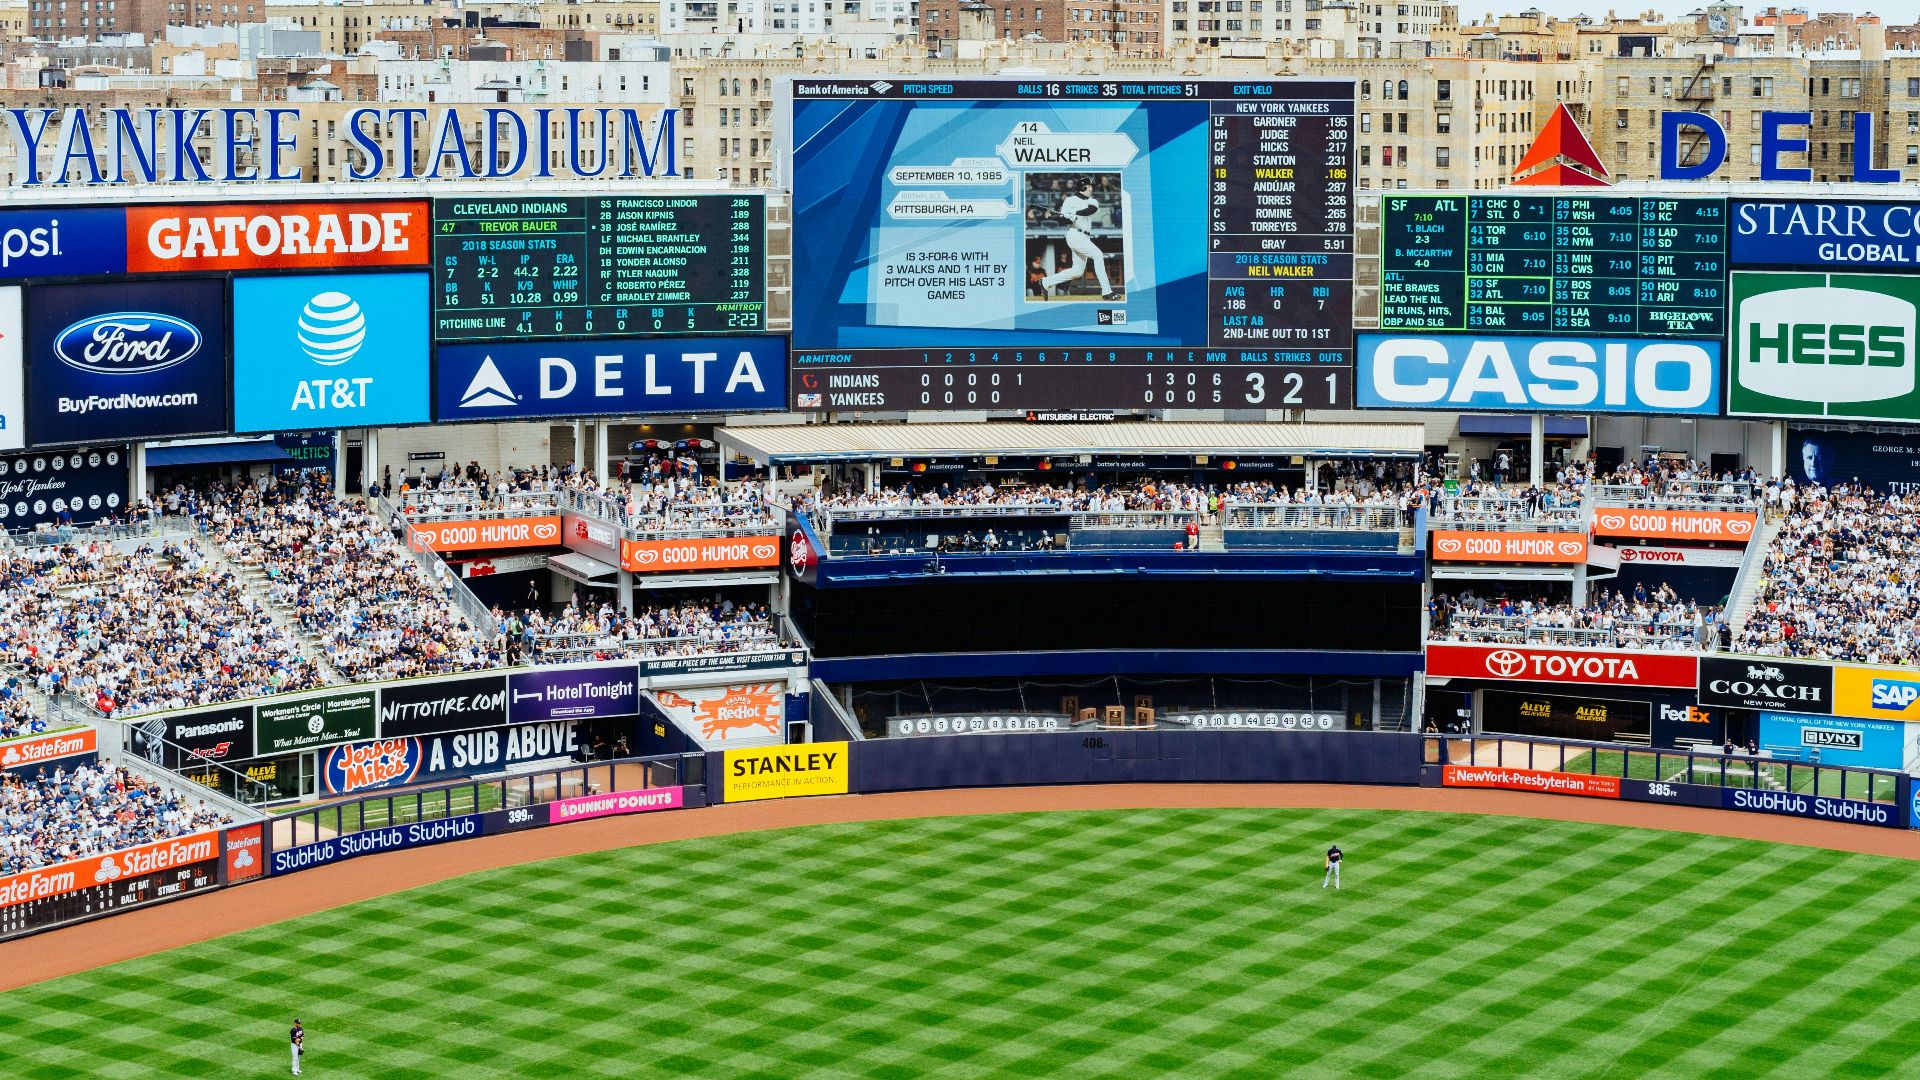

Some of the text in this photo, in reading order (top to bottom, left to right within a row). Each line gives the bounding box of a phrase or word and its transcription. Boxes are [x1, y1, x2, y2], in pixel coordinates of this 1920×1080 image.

[904, 84, 953, 94] PITCH SPEED
[1237, 104, 1329, 112] NEW YORK YANKEES
[1021, 123, 1037, 133] 14
[1215, 117, 1347, 127] LF GARDNER .195
[8, 108, 682, 184] YANKEE STADIUM
[1014, 137, 1035, 146] NEIL
[1015, 148, 1091, 162] WALKER
[896, 171, 1002, 181] SEPTEMBER 10, 1985
[1254, 181, 1295, 192] ANDÚJAR
[454, 203, 568, 214] CLEVELAND INDIANS
[617, 199, 749, 208] FRANCISCO LINDOR .286
[894, 205, 974, 214] PITTSBURGH, PA
[1738, 204, 1875, 236] STARR
[442, 222, 557, 233] 47 TREVOR BAUER
[148, 213, 410, 259] GATORADE
[617, 234, 700, 243] MICHAEL BRANTLEY
[2, 220, 59, 267] psi
[1406, 249, 1452, 257] MCCARTHY
[1819, 243, 1909, 262] GLOBAL
[1385, 284, 1439, 293] THE BRAVES
[716, 303, 761, 312] ARMITRON
[440, 317, 506, 329] PITCHING LINE
[728, 313, 758, 327] 2:23
[1667, 320, 1694, 329] TEA
[1224, 329, 1330, 339] 2ND-LINE OUT TO 1ST
[84, 324, 172, 362] Ford
[1750, 323, 1904, 367] HESS
[1241, 353, 1342, 362] BALLS STRIKES OUTS
[539, 352, 765, 399] DELTA
[1373, 339, 1712, 408] CASIO
[830, 375, 879, 387] INDIANS
[292, 378, 373, 410] AT&T
[1246, 373, 1336, 404] 3 2 1
[58, 393, 197, 413] BuyFordNow.com
[830, 393, 885, 405] YANKEES
[1037, 413, 1114, 421] MITSUBISHI ELECTRIC
[286, 446, 329, 459] THLETICS
[0, 477, 65, 499] York Yankees
[1630, 515, 1722, 533] GOOD HUMOR
[441, 525, 529, 544] GOOD HUMOR
[663, 544, 749, 563] GOOD HUMOR
[1466, 538, 1554, 555] GOOD HUMOR
[1639, 551, 1684, 562] TOYOTA
[737, 656, 750, 664] VISIT
[1530, 655, 1638, 679] TOYOTA
[547, 681, 633, 700] HotelTonight
[1709, 680, 1821, 701] COACH
[1873, 684, 1917, 705] SAP
[328, 697, 370, 708] Morningside
[381, 690, 506, 723] NITTOTIRE.COM
[1520, 702, 1551, 712] ALEVE
[262, 706, 299, 718] Workmen's
[301, 703, 321, 711] Circle
[718, 706, 760, 720] RedHot
[1661, 704, 1710, 723] FedEx
[176, 718, 244, 739] Panasonic
[293, 735, 319, 745] Matters
[344, 728, 360, 737] You!
[1818, 732, 1857, 745] LYNX
[430, 720, 578, 771] A SUB ABOVE
[339, 738, 408, 768] Jersey
[246, 765, 276, 778] ALEVE
[734, 753, 837, 776] STANLEY
[734, 778, 791, 790] PERFORMANCE
[1456, 770, 1584, 790] NewYork-Presbyterian
[569, 792, 671, 816] DUNKIN' DONUTS
[1734, 791, 1886, 822] StubHub StubHub
[277, 818, 474, 871] StubHub StubHub StubHub
[178, 870, 190, 880] POS
[128, 880, 149, 892] AT BAT
[194, 878, 207, 887] OUT
[158, 884, 180, 896] STRIKE
[121, 895, 137, 904] BALL
